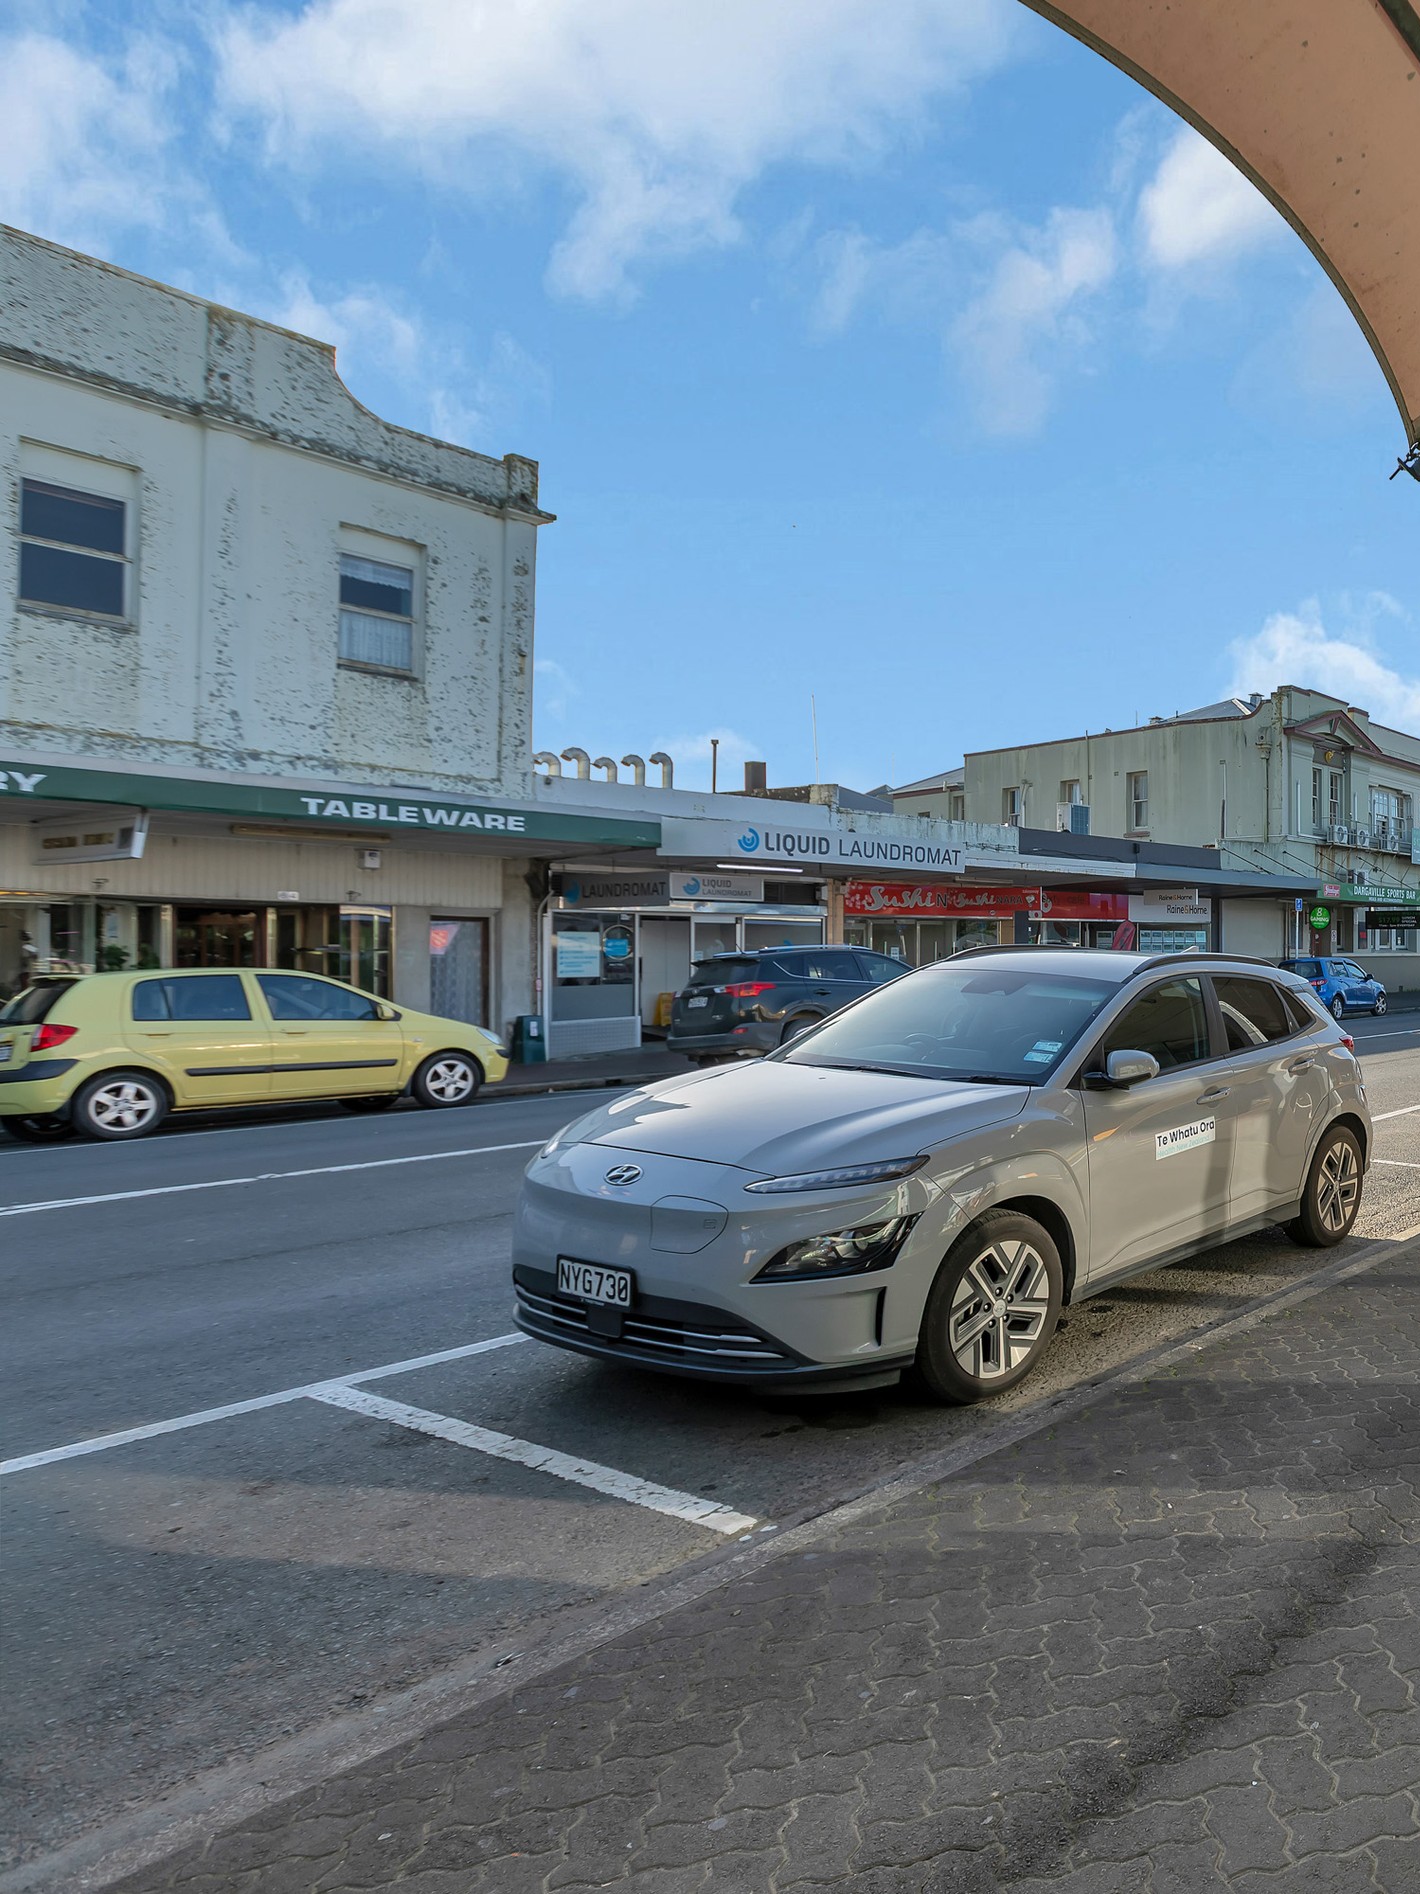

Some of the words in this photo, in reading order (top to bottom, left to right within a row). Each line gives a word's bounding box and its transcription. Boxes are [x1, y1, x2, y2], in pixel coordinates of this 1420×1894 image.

[301, 797, 525, 831] TABLEWARE
[765, 832, 830, 857] LIQUID
[839, 839, 961, 866] LAUNDROMAT
[581, 881, 666, 898] LAUNDROMAT
[702, 879, 732, 888] LIQUID
[702, 889, 752, 897] LAUNDROMAT
[1353, 886, 1385, 897] DARGAVILLE
[1387, 888, 1404, 900] SPORTS
[1405, 890, 1416, 900] BAR
[864, 885, 935, 911] Sushi
[953, 892, 996, 908] Sushi
[996, 895, 1023, 905] NARA
[1157, 1136, 1168, 1147] Te
[1169, 1125, 1199, 1143] Whatu
[1200, 1121, 1214, 1132] Ora
[560, 1263, 628, 1302] NYG730
